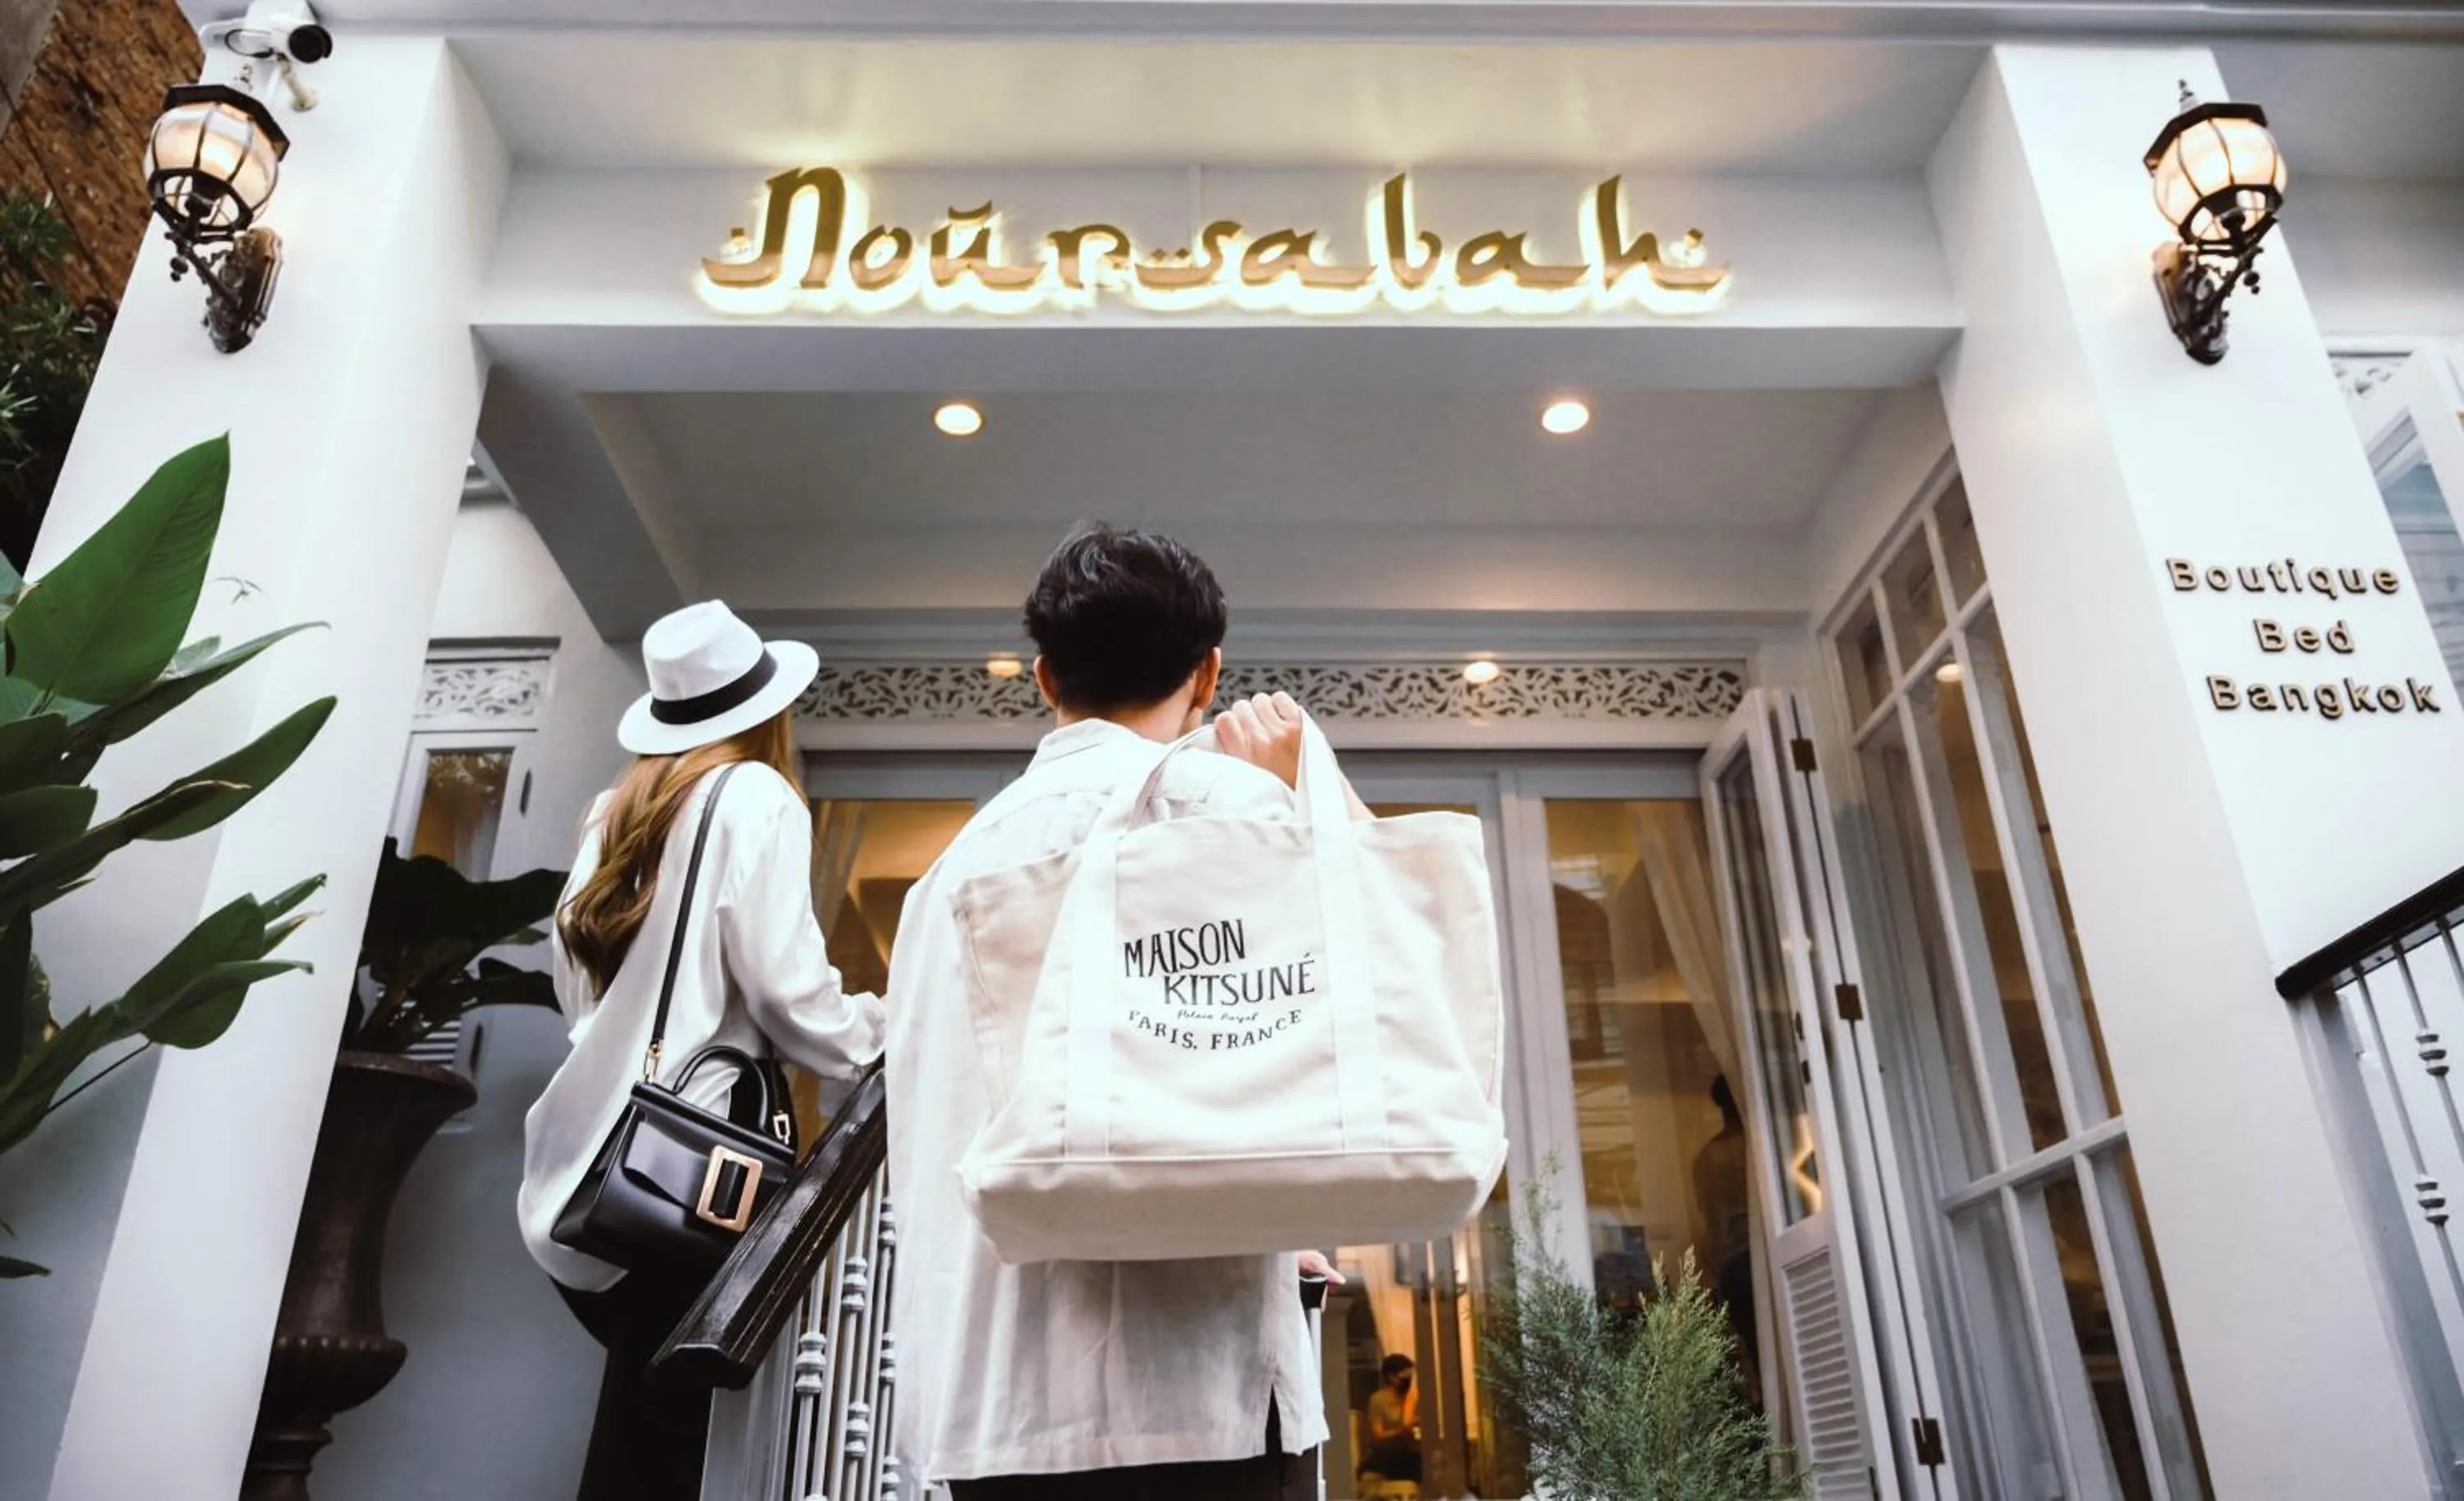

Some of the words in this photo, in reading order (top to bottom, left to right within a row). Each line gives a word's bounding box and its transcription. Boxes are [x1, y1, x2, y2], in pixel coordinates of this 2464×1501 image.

[2166, 558, 2400, 600] Boutique
[2253, 617, 2355, 654] Bed
[2207, 675, 2441, 719] Bangkok
[1124, 919, 1246, 977] MAISON
[1163, 952, 1316, 1006] KITSUNÉ
[1210, 1009, 1303, 1050] FRANCE
